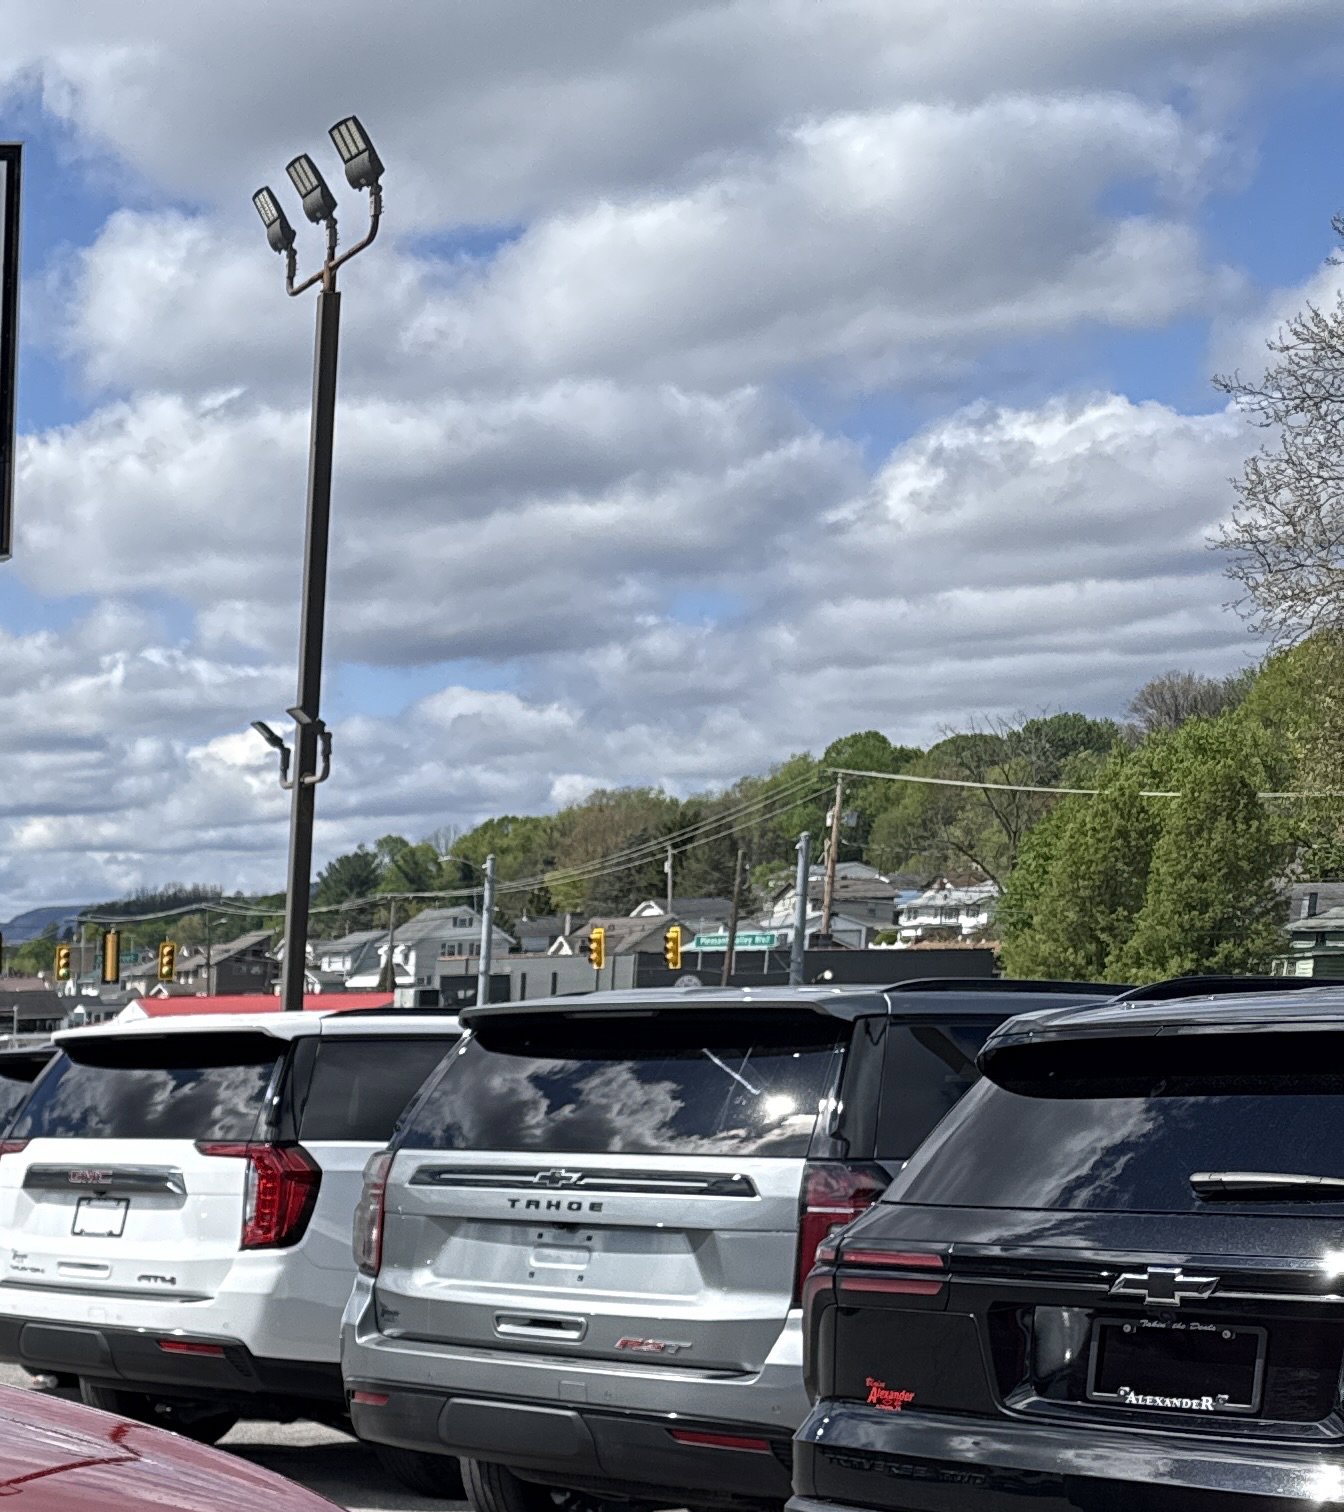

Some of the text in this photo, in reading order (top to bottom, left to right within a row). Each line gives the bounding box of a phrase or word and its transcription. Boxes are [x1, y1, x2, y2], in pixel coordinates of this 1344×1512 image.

[507, 1198, 604, 1212] TAHOE
[614, 1336, 692, 1354] RST
[867, 1387, 915, 1403] Alexander
[1125, 1391, 1214, 1410] ALEXANDER
